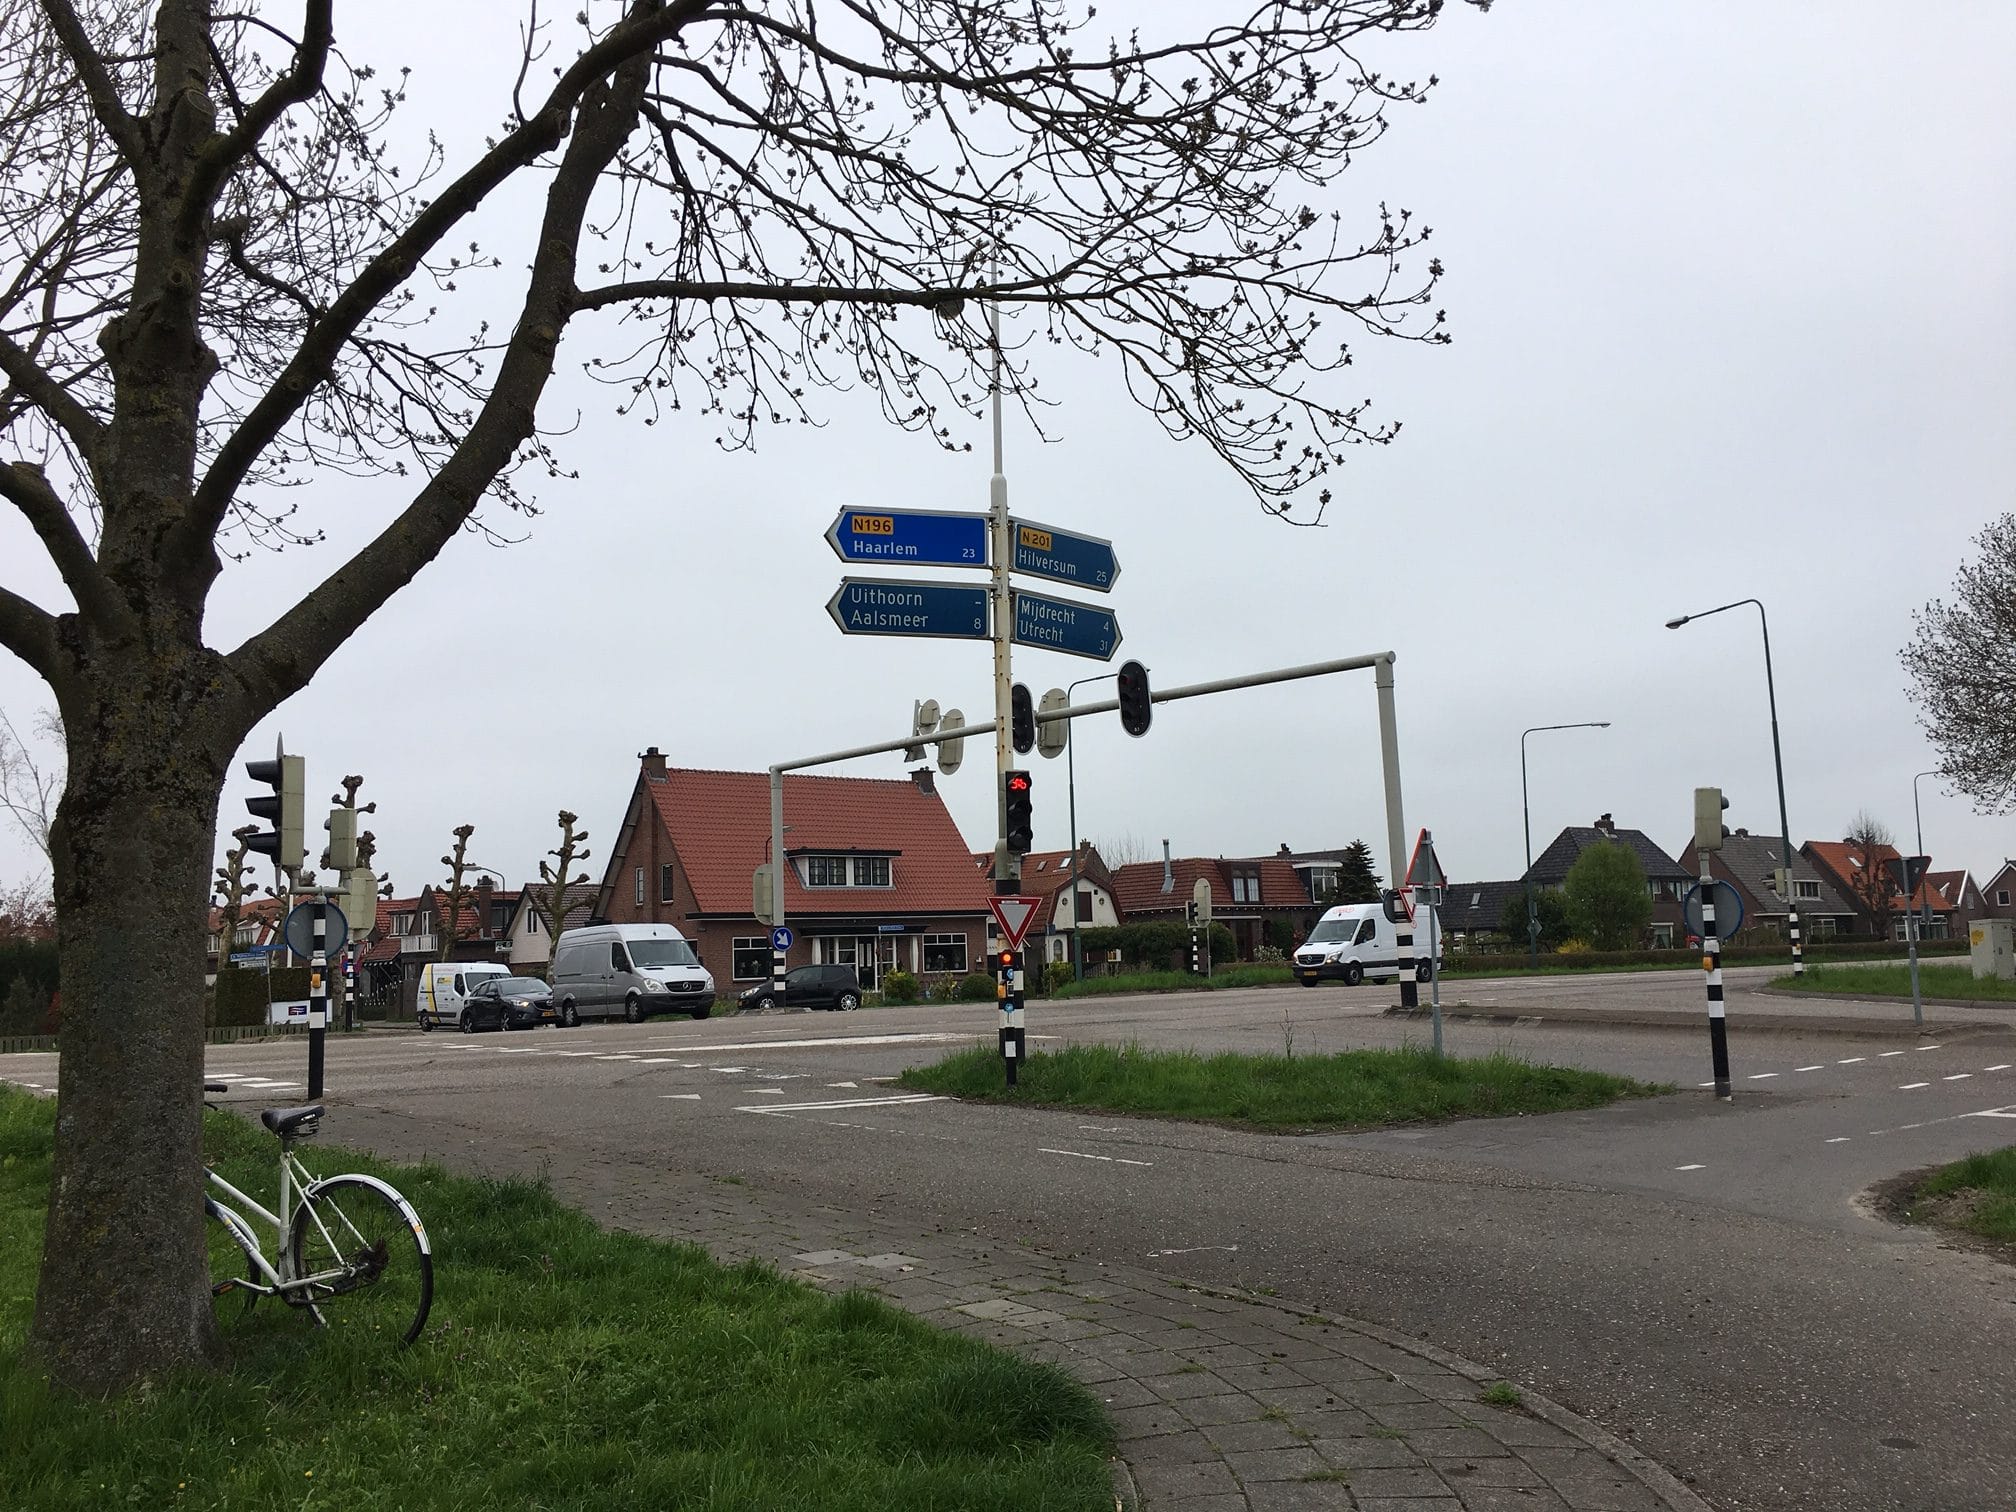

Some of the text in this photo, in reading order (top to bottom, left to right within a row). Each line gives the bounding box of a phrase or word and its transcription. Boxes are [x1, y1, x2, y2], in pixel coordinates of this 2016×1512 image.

[853, 517, 892, 532] N196
[853, 540, 976, 558] Haarlem 23
[1018, 548, 1107, 583] Hilversum 25
[851, 587, 923, 606] Uithoorn
[851, 609, 982, 630] Aalsmeer 8
[1021, 599, 1109, 632] Mijdrecht 4
[1019, 619, 1108, 652] Utrecht 31
